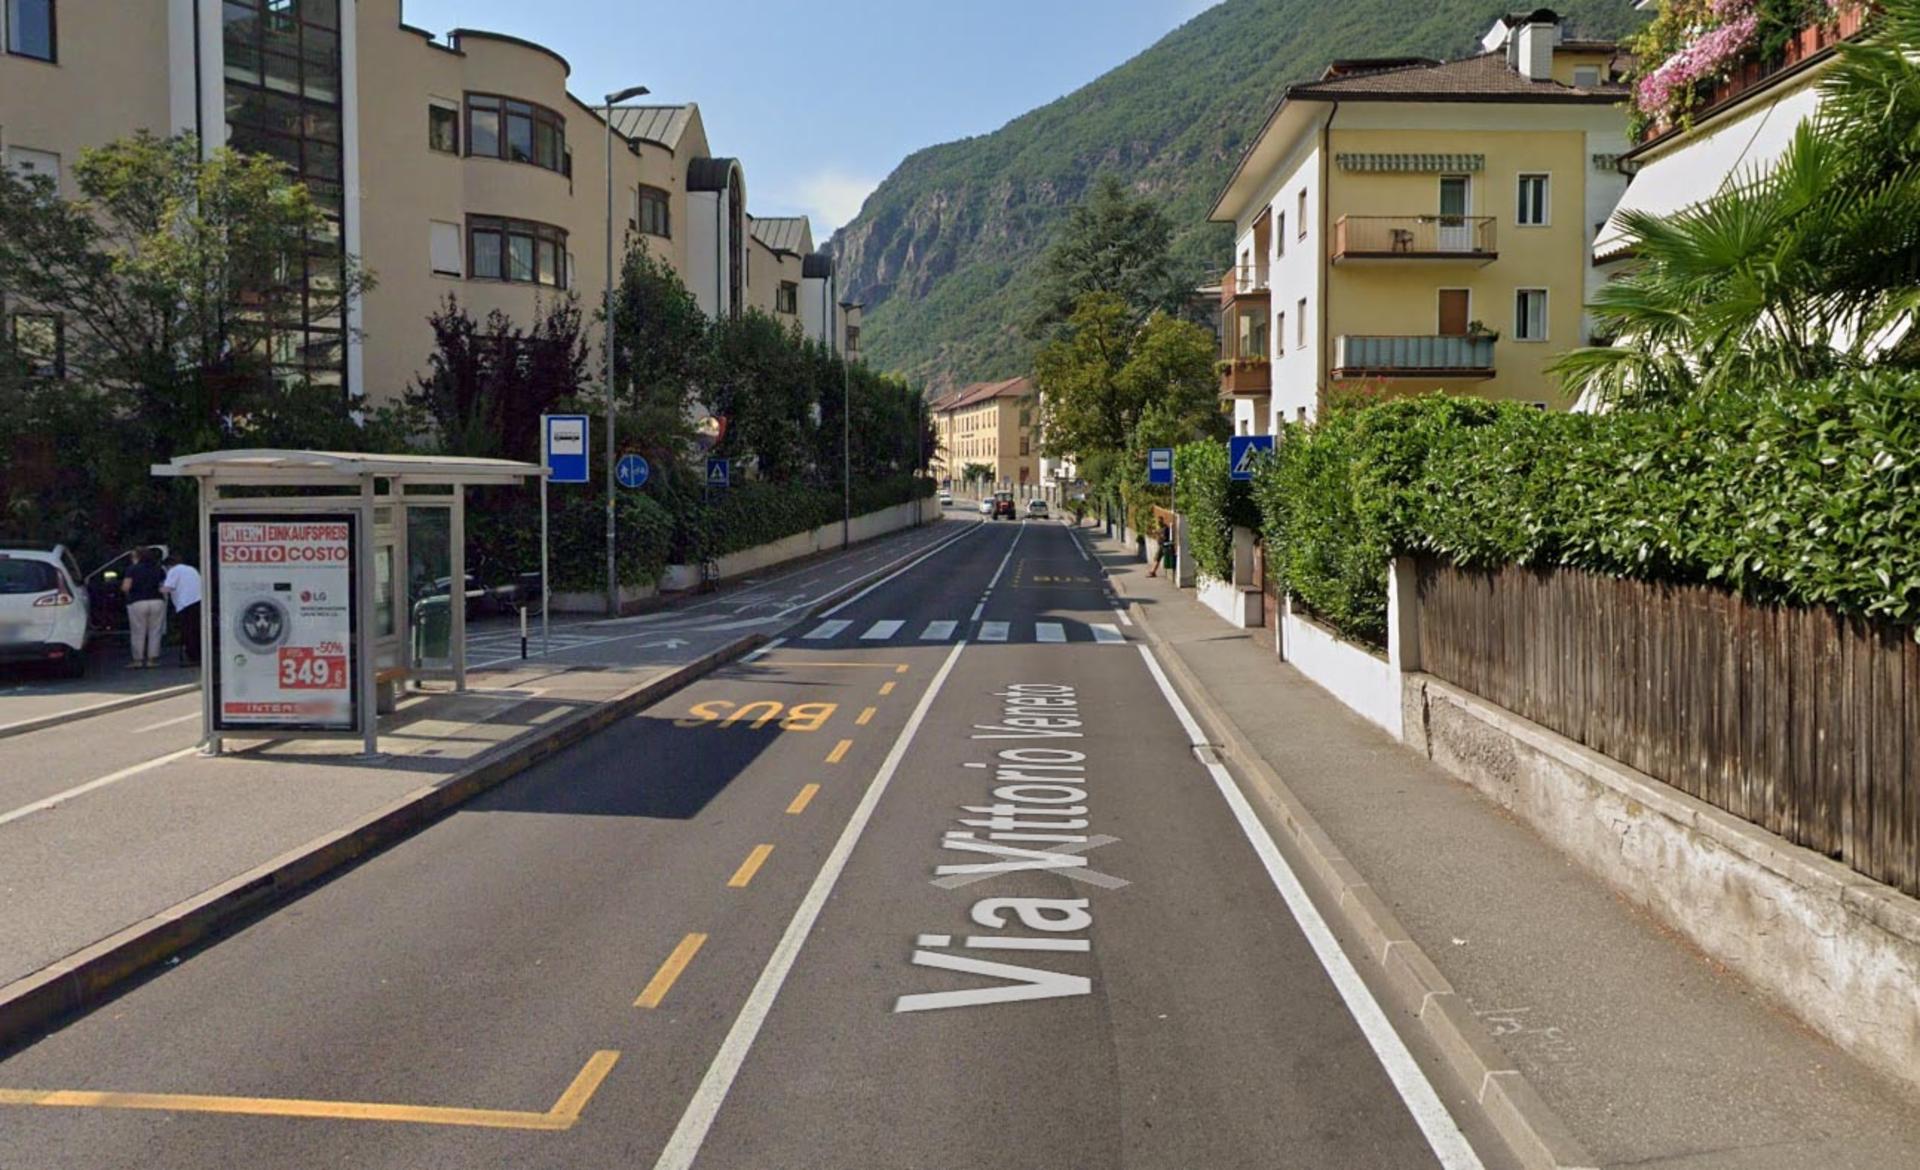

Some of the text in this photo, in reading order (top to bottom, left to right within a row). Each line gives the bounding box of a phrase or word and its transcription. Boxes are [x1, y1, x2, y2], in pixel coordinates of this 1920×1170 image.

[269, 525, 347, 541] EINKAUFSPREIS
[224, 546, 348, 561] SOTTO COSTO
[313, 591, 327, 602] LG
[282, 658, 329, 685] 349
[673, 700, 838, 731] BUS
